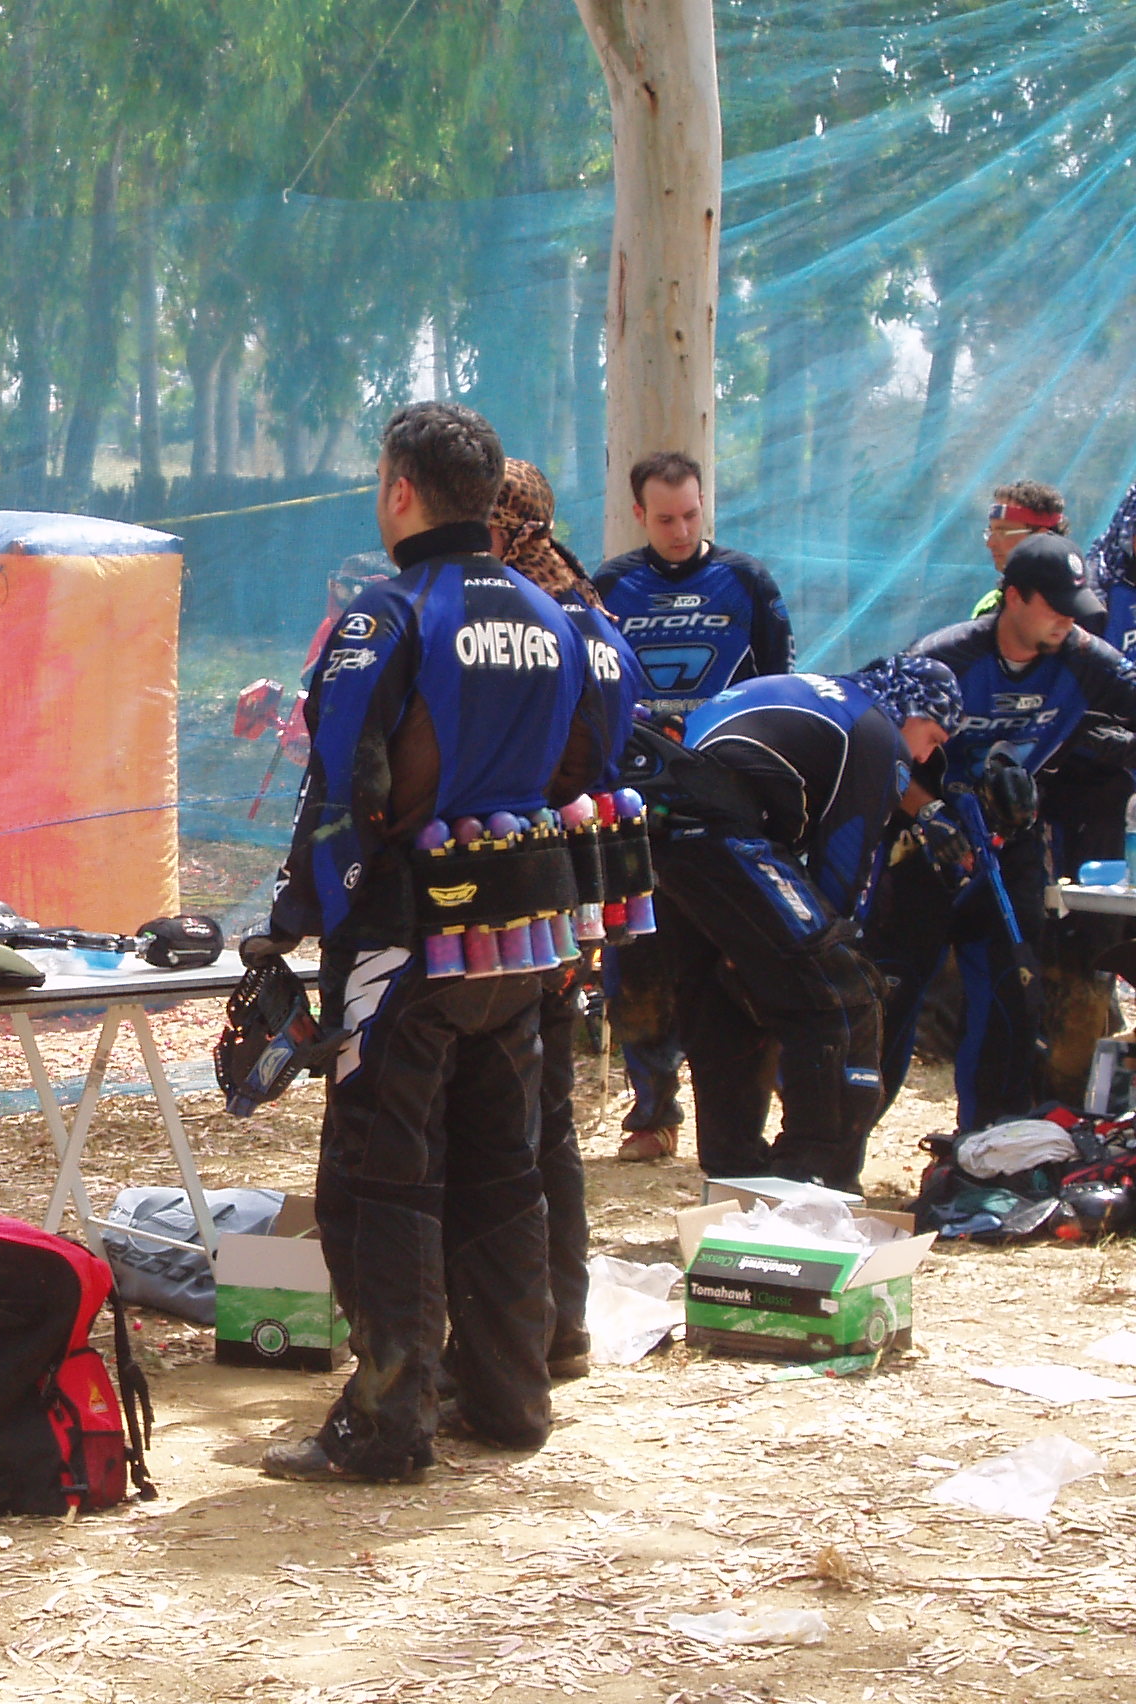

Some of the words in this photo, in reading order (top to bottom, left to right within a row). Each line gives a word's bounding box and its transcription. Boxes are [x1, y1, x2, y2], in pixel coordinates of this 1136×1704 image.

[464, 577, 516, 588] ANGEL
[622, 612, 731, 635] proto
[456, 621, 559, 670] OMEYAS
[691, 1282, 752, 1302] Tomahawk
